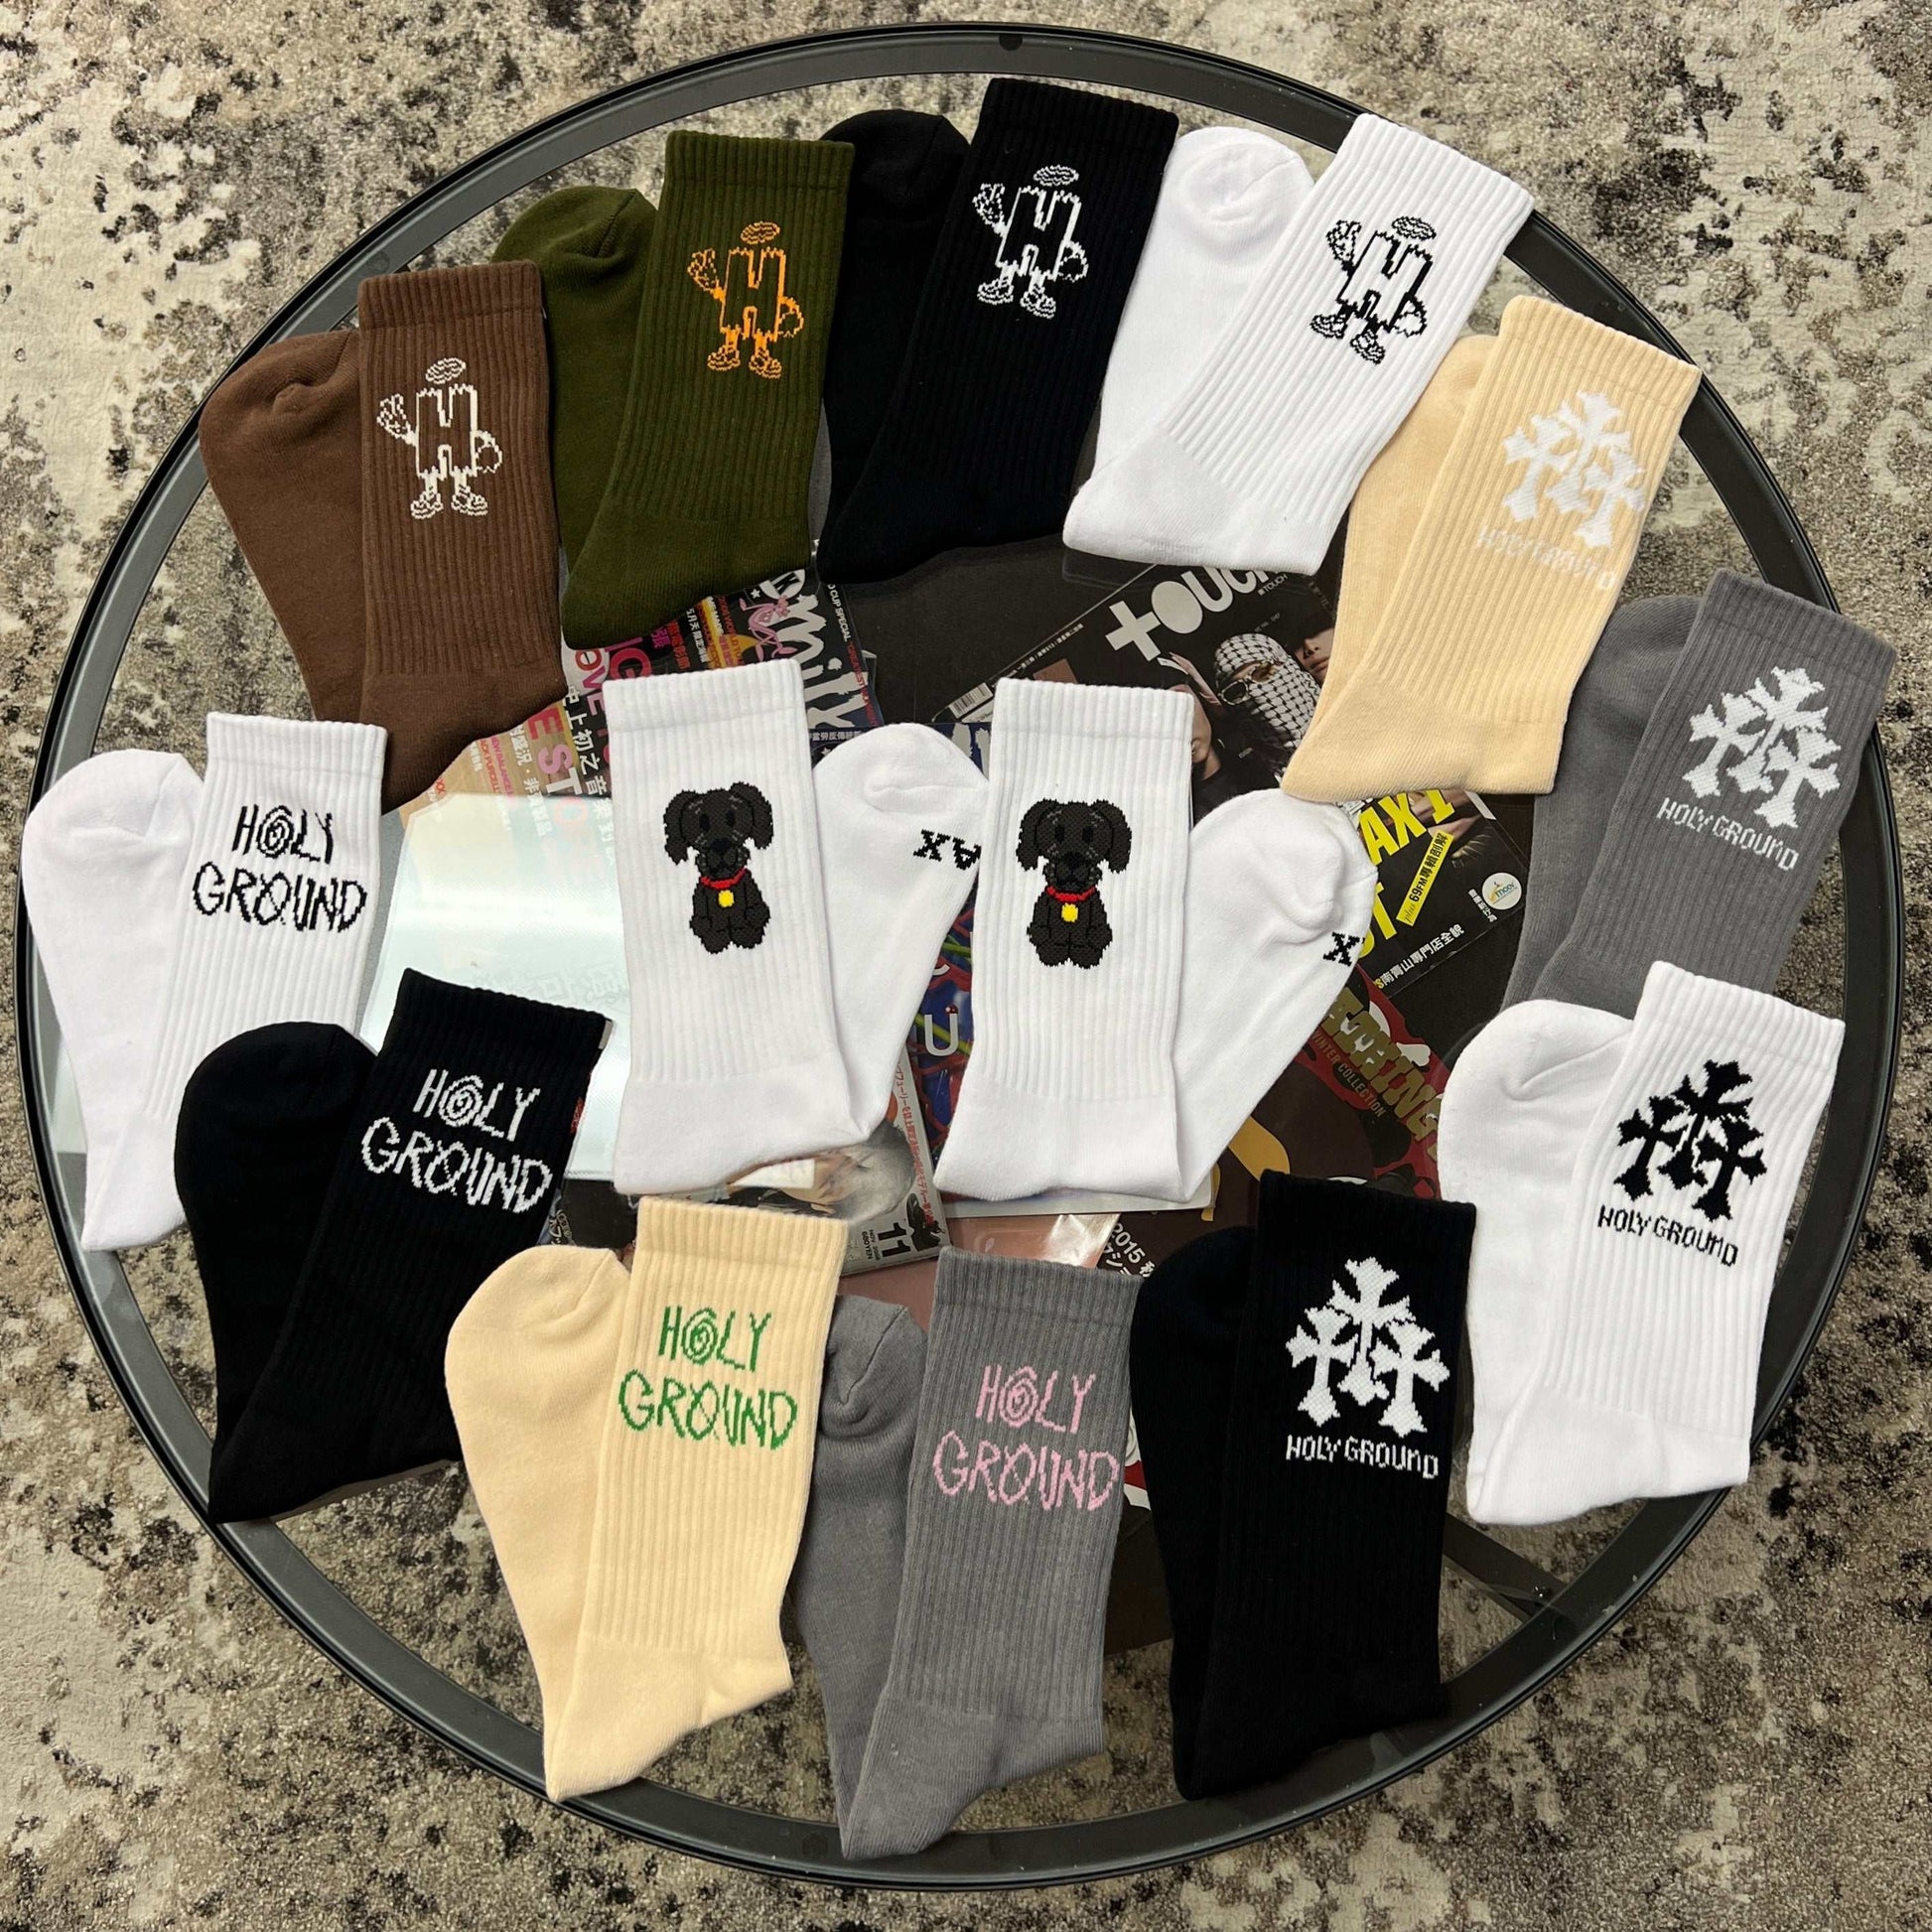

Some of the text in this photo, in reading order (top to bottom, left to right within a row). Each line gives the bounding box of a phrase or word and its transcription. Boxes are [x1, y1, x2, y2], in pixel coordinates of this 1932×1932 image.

[829, 590, 841, 609] CUP
[835, 608, 852, 642] SPECIAL
[478, 738, 490, 758] ACK
[231, 804, 334, 864] HOLY
[1359, 792, 1427, 866] AX
[1656, 797, 1799, 871] HOLY GROUND
[193, 862, 367, 932] GROUND
[412, 1069, 541, 1142] HOLY
[1337, 1062, 1386, 1118] COLLECTION
[361, 1117, 553, 1213] GROUND
[878, 1222, 911, 1258] 11
[1597, 1204, 1738, 1267] HOLY GROUND
[658, 1306, 771, 1372] HOLY
[619, 1369, 798, 1449] GROUND
[975, 1364, 1096, 1434] HOLY
[933, 1431, 1120, 1511] GROUND
[1286, 1434, 1439, 1478] HOLY GROUND
